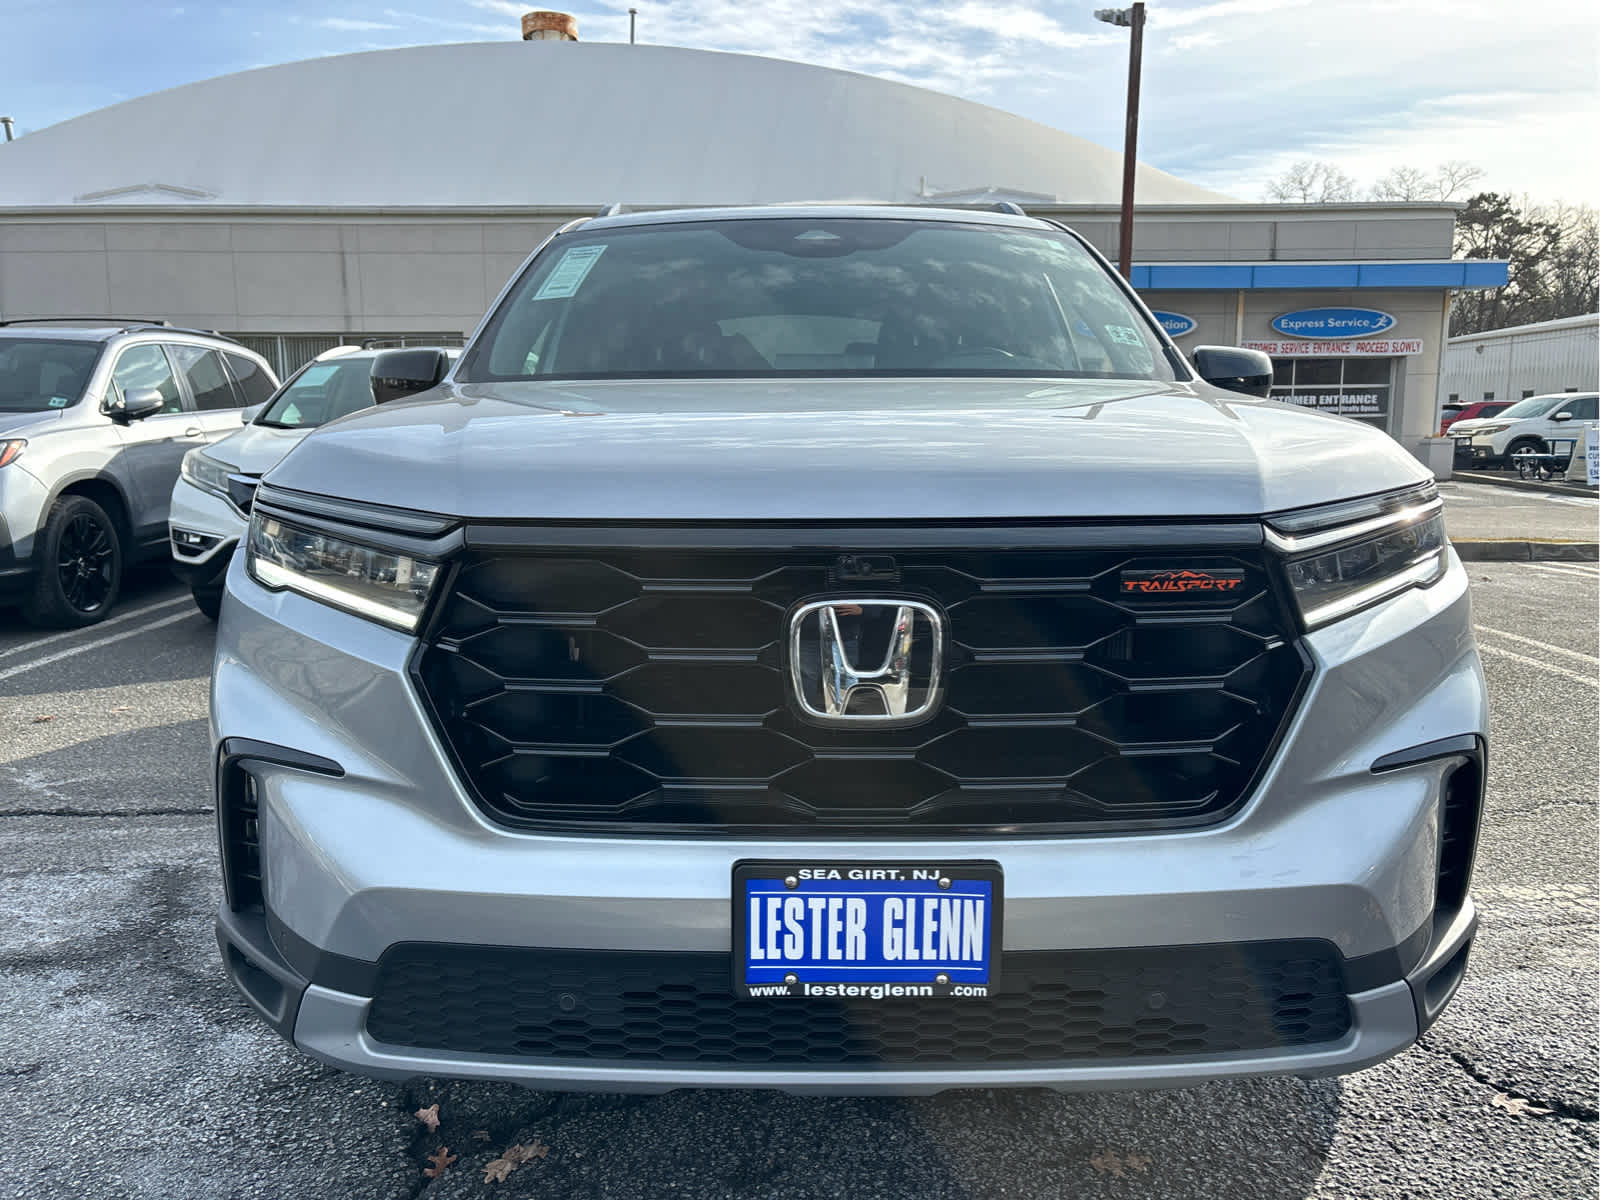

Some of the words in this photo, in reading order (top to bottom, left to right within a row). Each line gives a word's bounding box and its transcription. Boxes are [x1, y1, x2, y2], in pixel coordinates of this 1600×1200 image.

[1281, 319, 1325, 330] Express
[1327, 318, 1370, 328] Service
[1281, 342, 1309, 353] SERVICE
[1313, 342, 1350, 353] ENTRANCE
[1356, 342, 1389, 353] PROCEED
[1392, 341, 1421, 353] SLOWLY
[1319, 394, 1378, 404] ENTRANCE
[1124, 579, 1241, 592] TRAILSPORT
[798, 869, 843, 880] SEA
[848, 869, 905, 881] GIRT,
[912, 870, 941, 880] NJ
[750, 897, 867, 960] LESTER
[882, 897, 985, 961] GLENN
[750, 986, 791, 997] www.
[804, 983, 933, 999] lesterglenn
